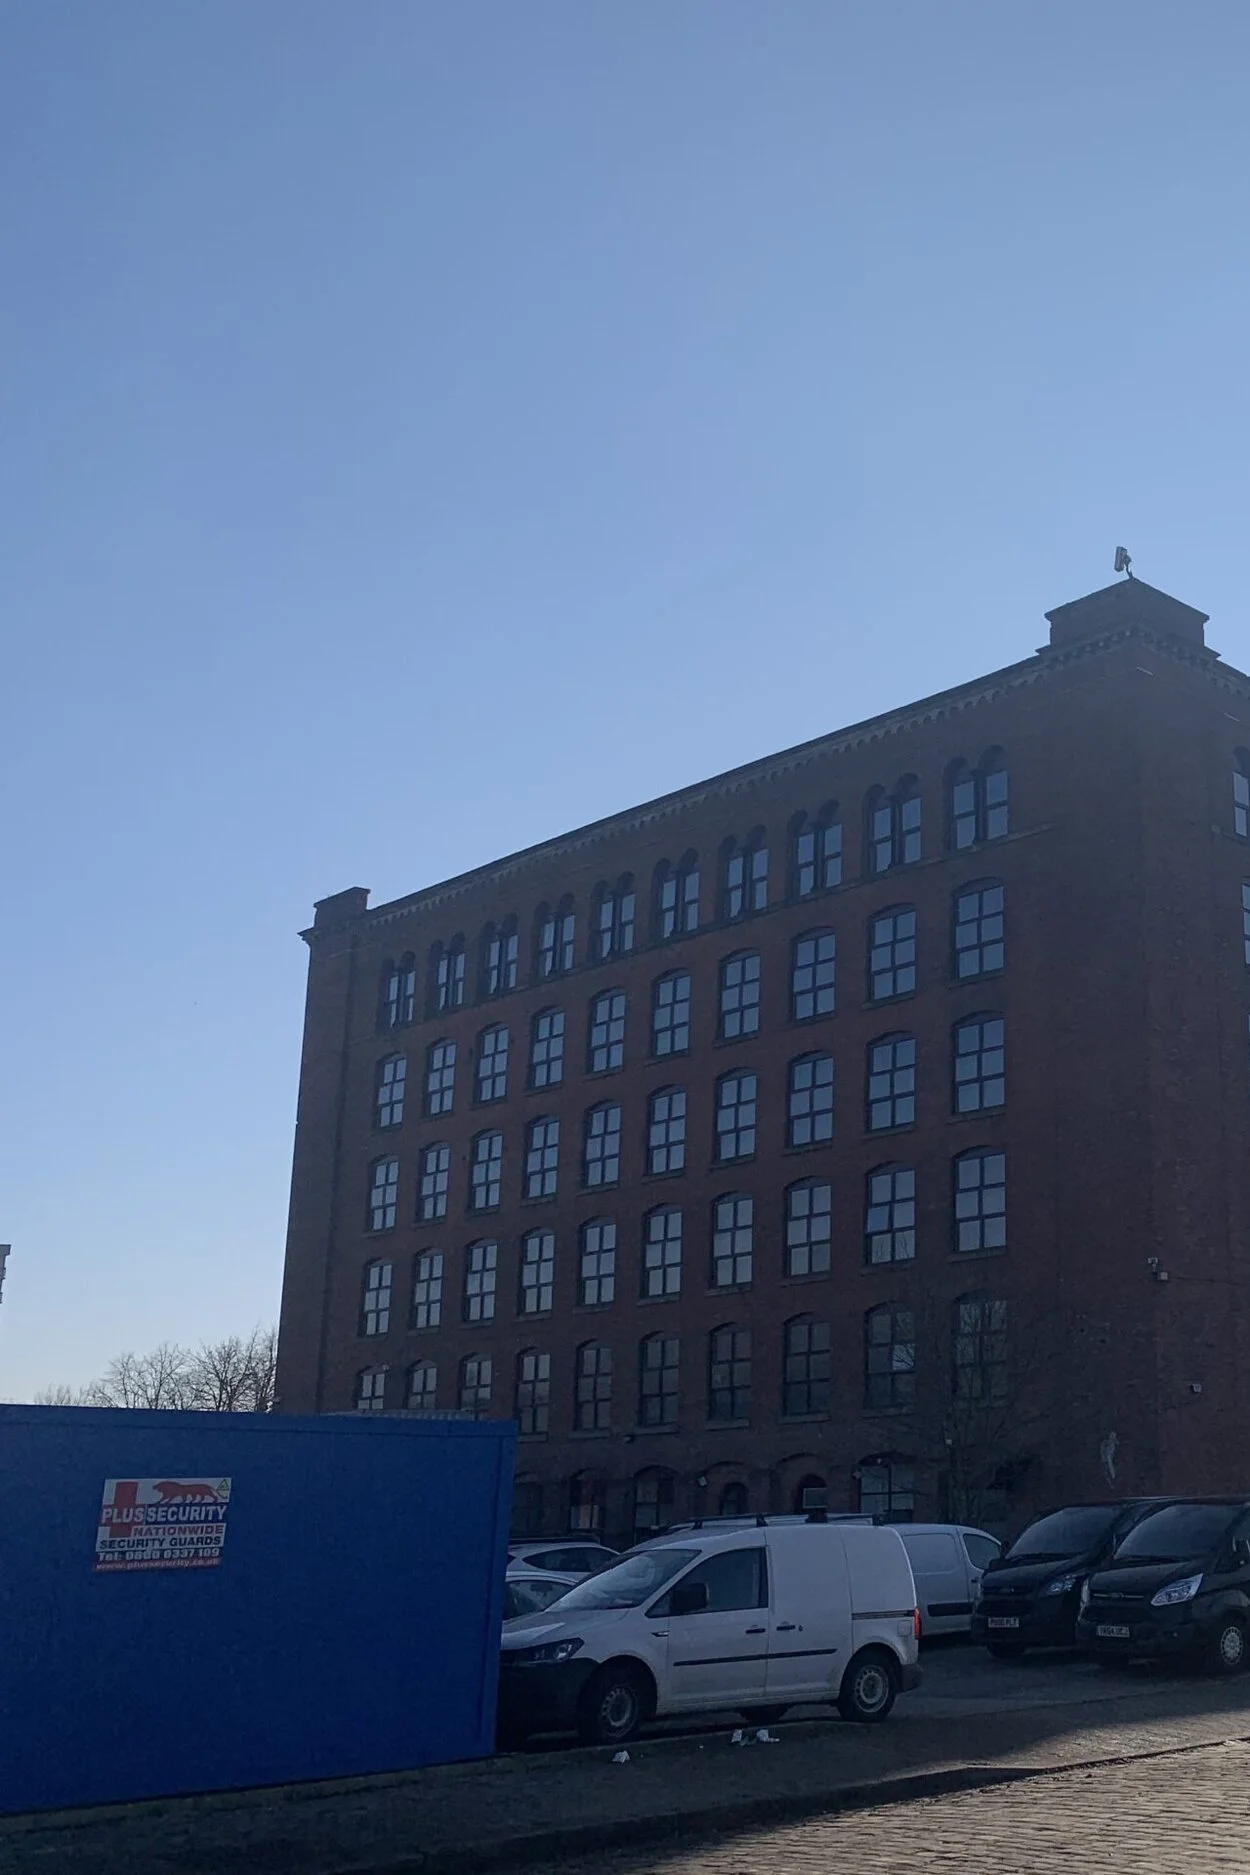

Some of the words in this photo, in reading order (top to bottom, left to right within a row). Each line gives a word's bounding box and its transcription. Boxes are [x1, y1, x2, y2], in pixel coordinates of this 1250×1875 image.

[101, 1507, 145, 1523] PLUS
[147, 1505, 227, 1522] SECURITY
[133, 1525, 224, 1537] NATIONWIDE
[99, 1537, 166, 1550] SECURITY
[169, 1535, 222, 1547] GUARDS
[126, 1549, 161, 1561] 0800
